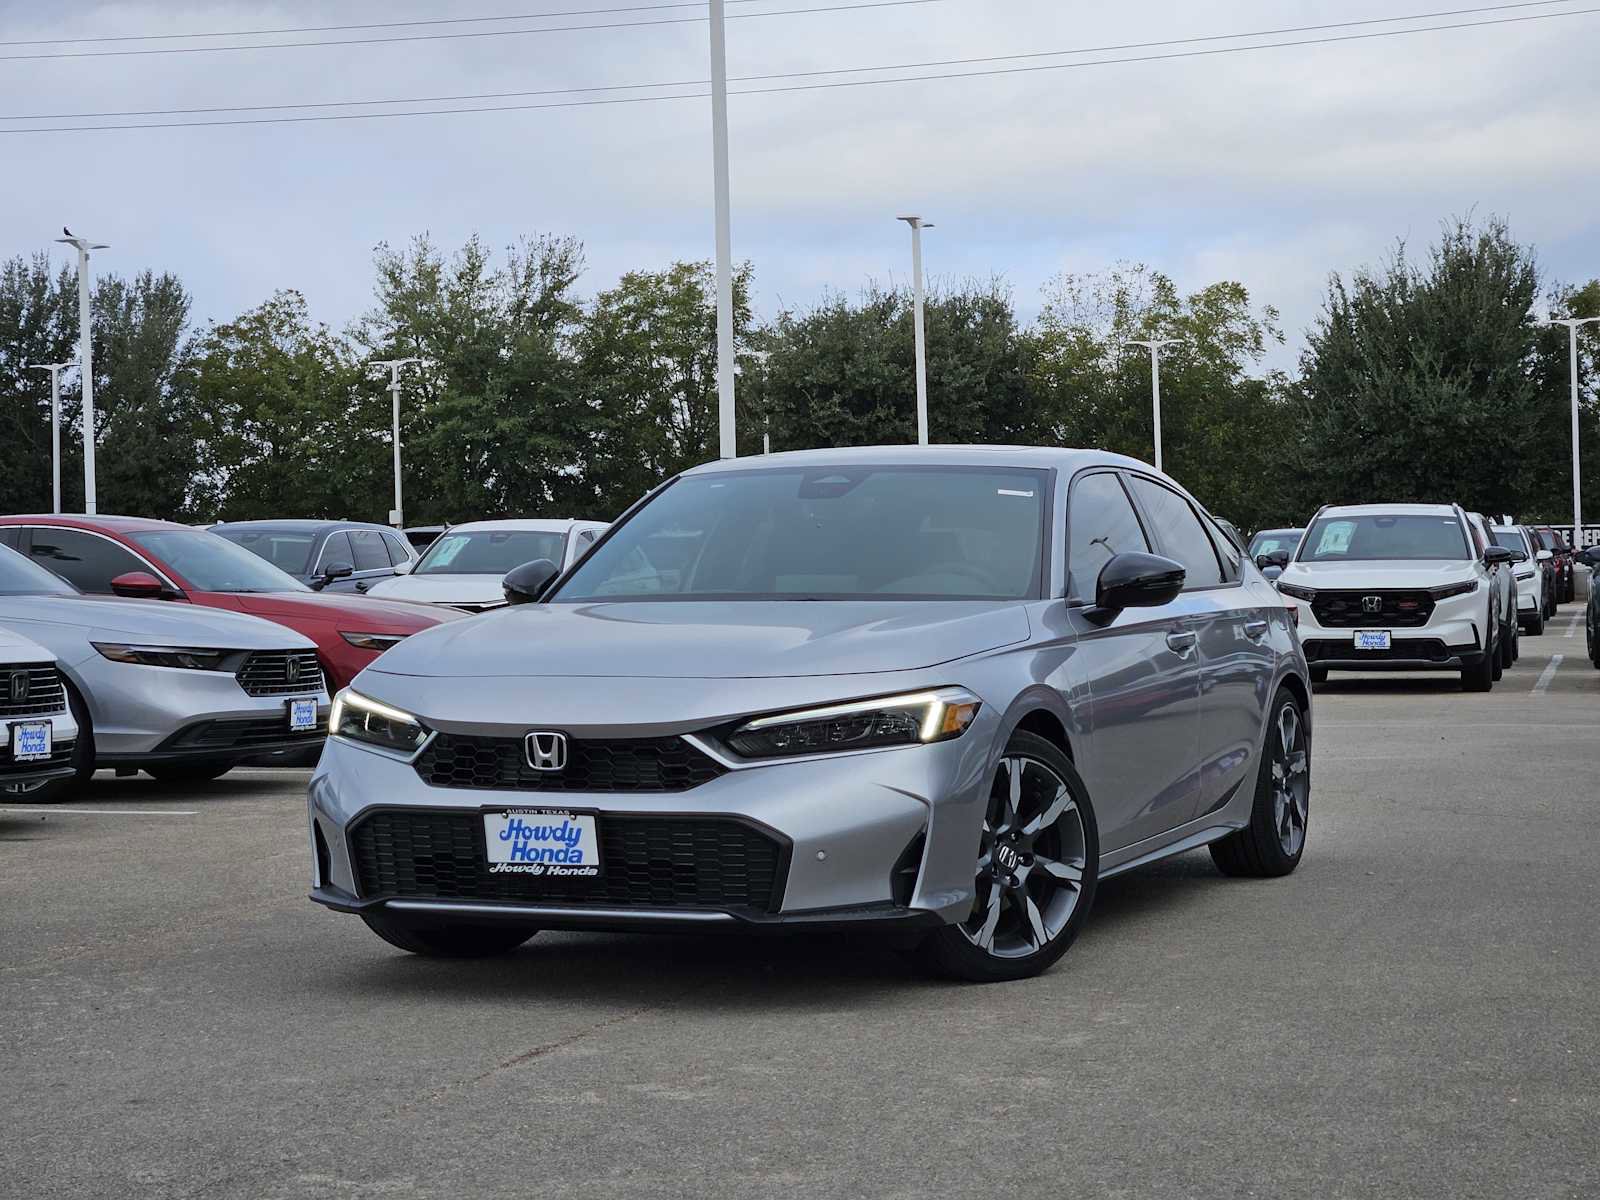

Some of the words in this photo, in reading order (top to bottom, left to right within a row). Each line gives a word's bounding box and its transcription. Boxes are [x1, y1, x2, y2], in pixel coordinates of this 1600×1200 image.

[1360, 632, 1386, 641] Howdy
[295, 713, 313, 724] Honda
[18, 726, 46, 743] Howdy
[22, 740, 45, 752] Honda
[499, 818, 582, 848] Howdy
[510, 840, 583, 864] Honda
[489, 862, 545, 876] Howdy
[546, 865, 599, 876] Honda
